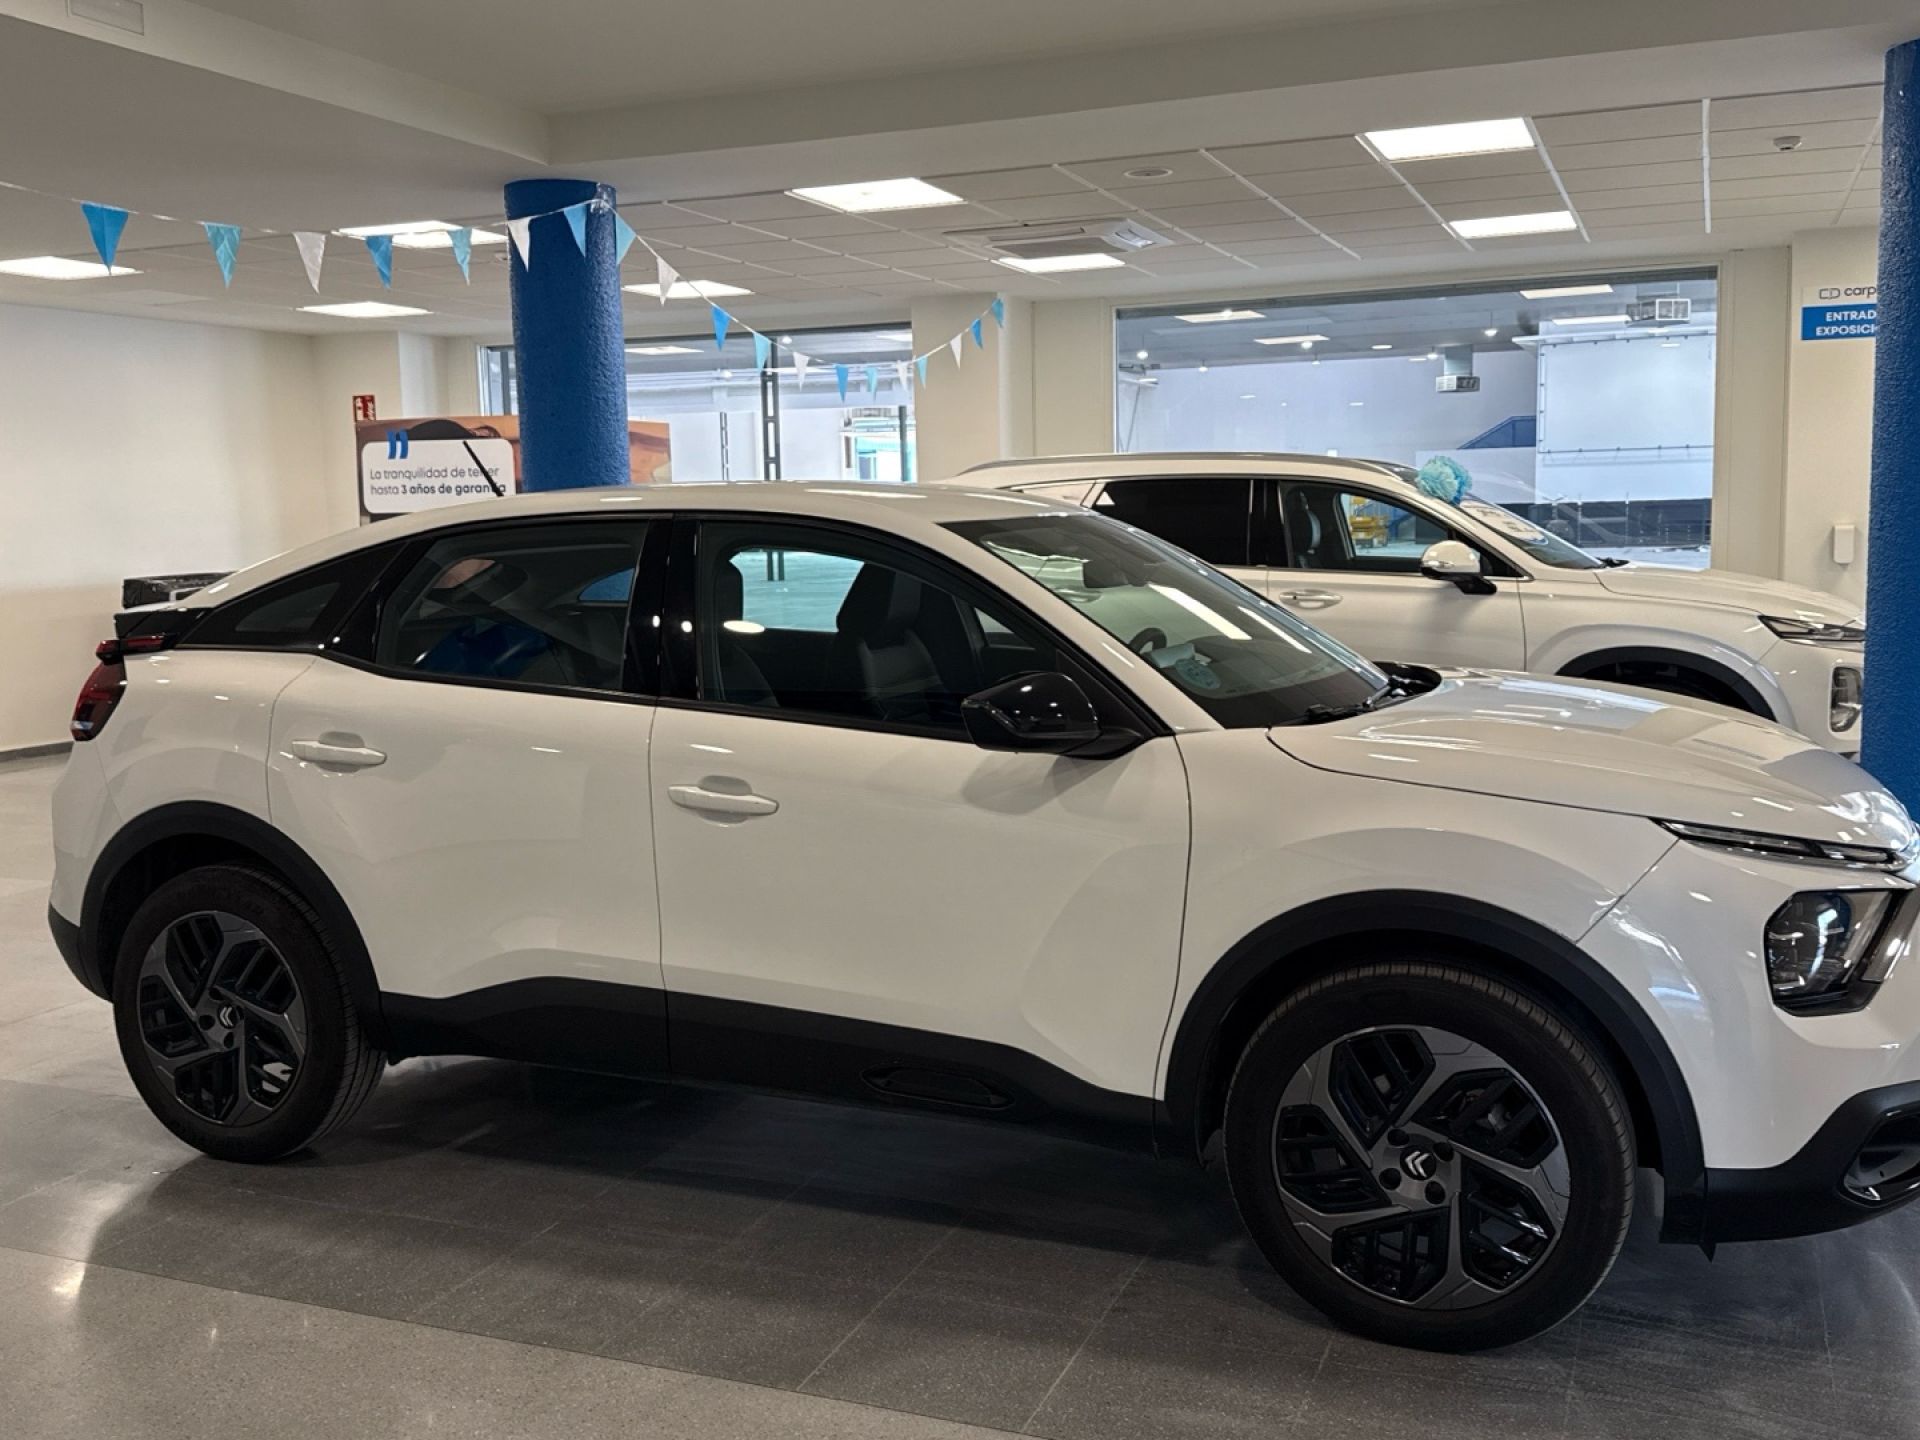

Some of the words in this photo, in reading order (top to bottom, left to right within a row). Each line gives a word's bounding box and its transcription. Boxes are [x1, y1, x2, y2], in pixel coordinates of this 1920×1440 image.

[1815, 324, 1879, 336] EXPOSICI
[370, 469, 382, 480] La
[384, 466, 448, 481] tranquilidad
[450, 467, 466, 478] de
[370, 484, 399, 496] hasta
[401, 486, 408, 495] 3
[409, 484, 436, 495] años
[438, 483, 453, 494] de
[455, 483, 507, 497] garana
